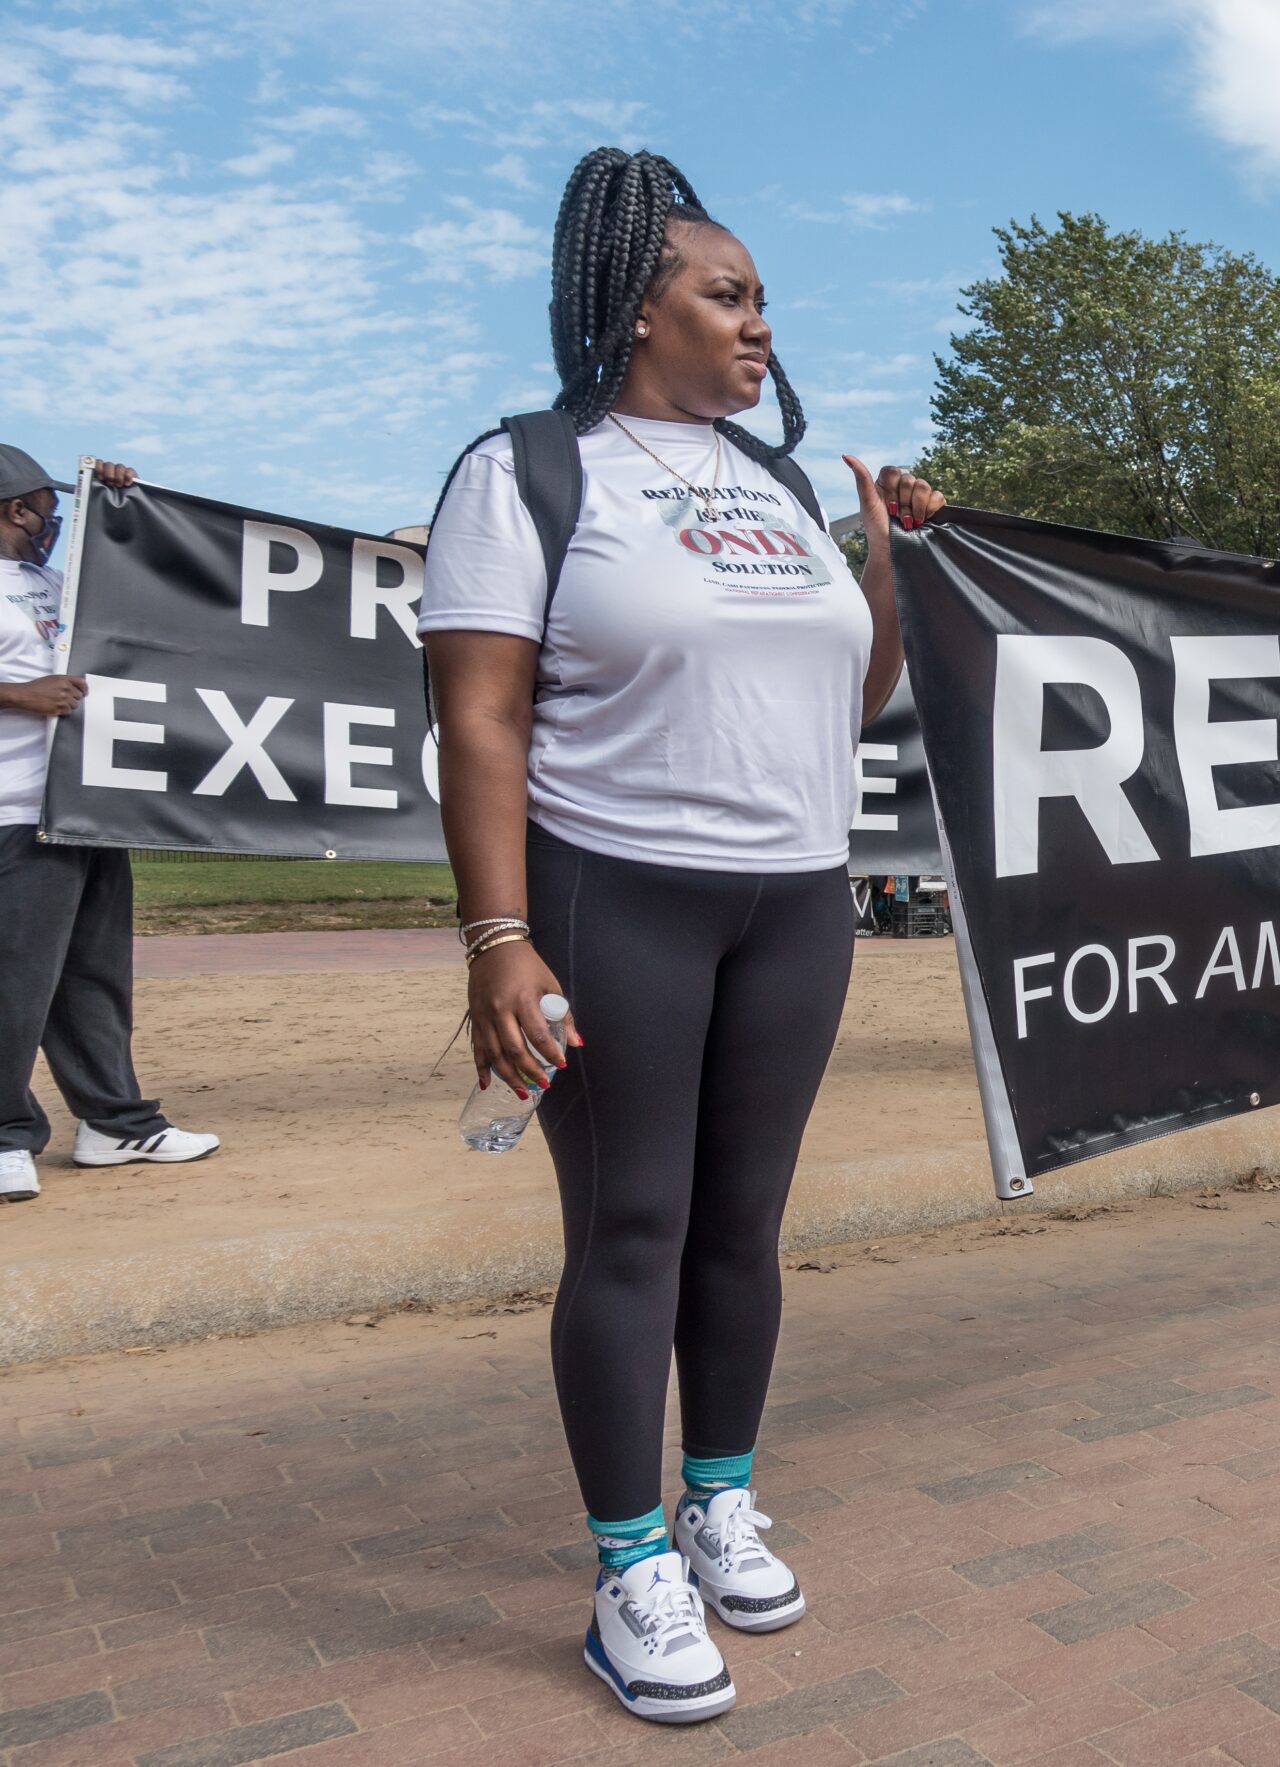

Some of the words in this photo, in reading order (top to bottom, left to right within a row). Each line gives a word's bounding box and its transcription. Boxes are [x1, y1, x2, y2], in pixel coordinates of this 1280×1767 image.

[641, 486, 782, 506] REPARATIONS
[718, 507, 765, 522] THE
[679, 528, 813, 557] ONLY
[711, 561, 813, 576] SOLUTION
[855, 928, 874, 937] atter
[1013, 934, 1178, 1039] FOR
